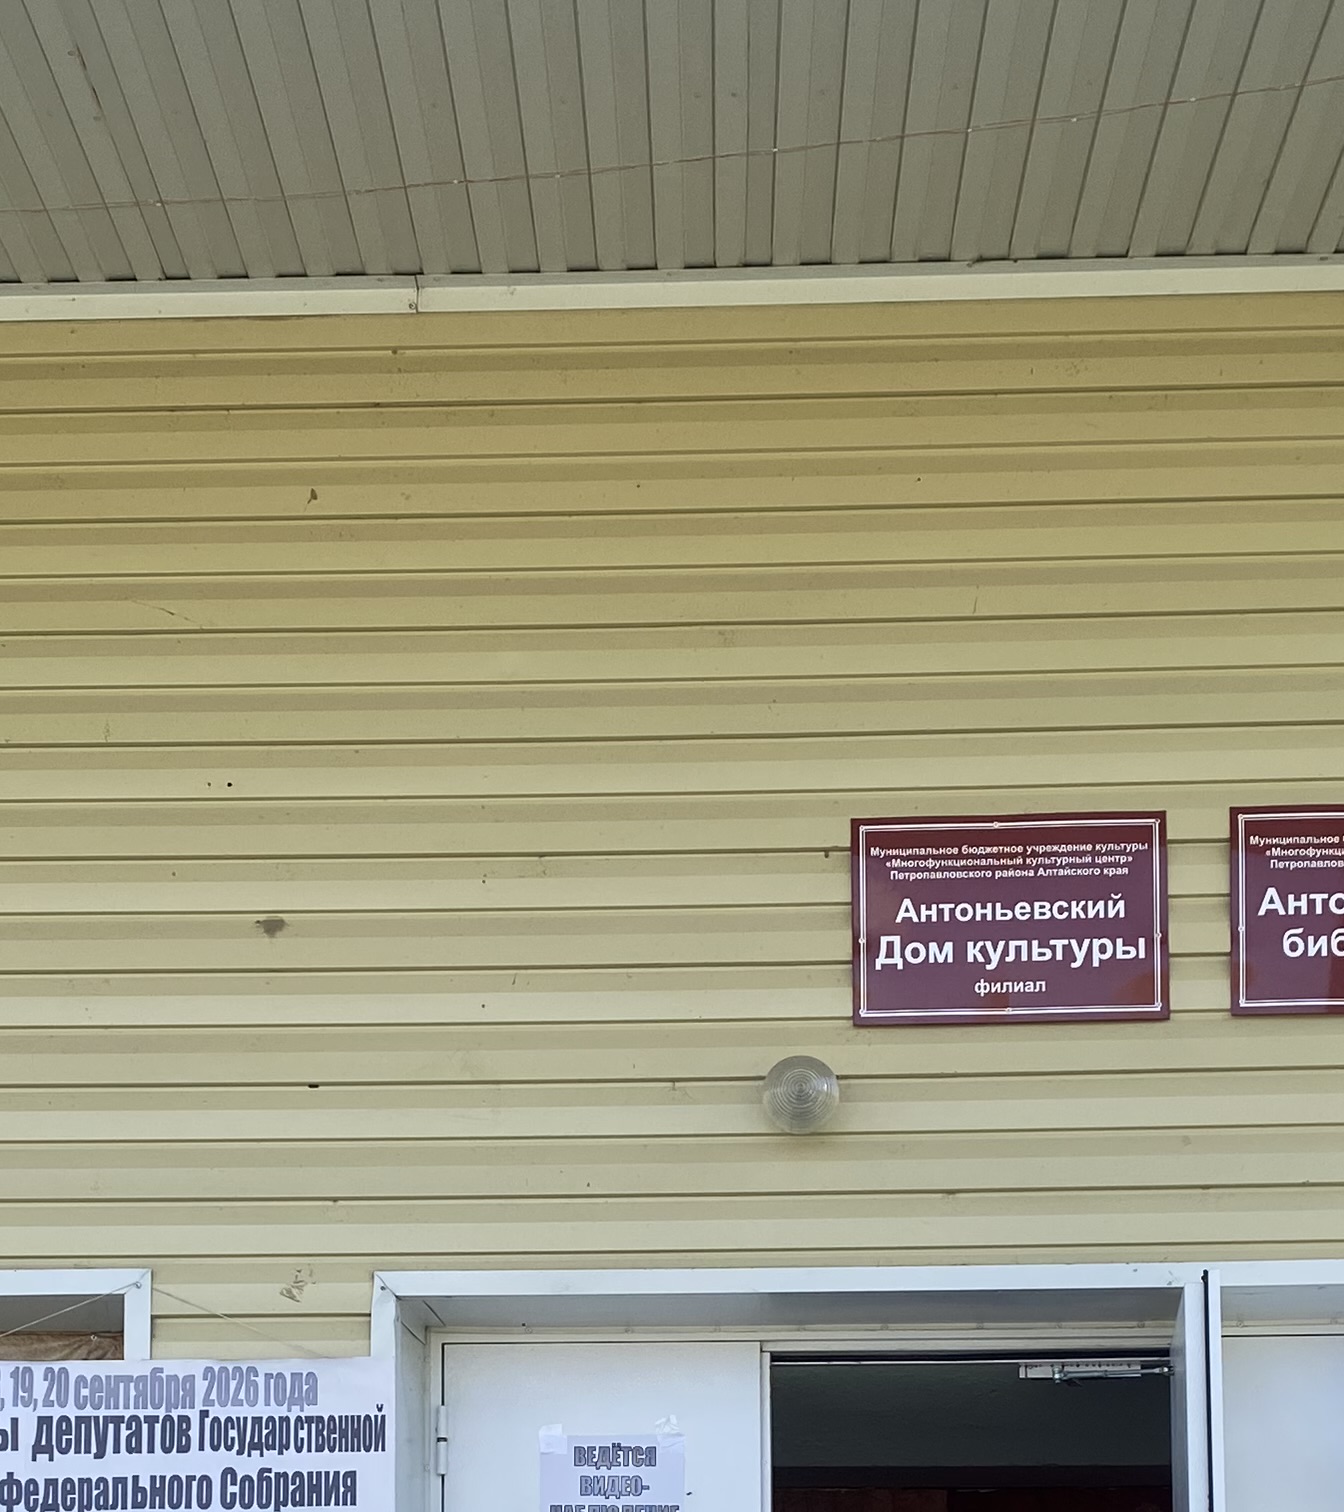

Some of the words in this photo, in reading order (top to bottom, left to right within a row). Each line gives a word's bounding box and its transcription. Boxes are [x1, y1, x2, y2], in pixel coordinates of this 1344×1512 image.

[870, 846, 958, 857] Муниципальное
[962, 844, 1023, 856] бюджетное
[1026, 843, 1093, 854] учреждение
[1095, 841, 1148, 852] культуры
[1249, 835, 1340, 846] Муниципальное
[886, 856, 1023, 868] «Многофункциональный
[1026, 855, 1092, 865] культурный
[1094, 854, 1133, 864] центр»
[890, 868, 992, 880] Петропавловского
[995, 868, 1034, 879] района
[1037, 866, 1101, 876] Алтайского
[1103, 866, 1129, 877] края
[895, 893, 1125, 923] Антоньевский
[875, 936, 953, 970] Дом
[967, 936, 1146, 970] культуры
[974, 979, 1046, 996] филиал
[10, 1366, 38, 1411] 19,
[43, 1366, 69, 1408] 20
[74, 1368, 196, 1413] сентября
[202, 1366, 258, 1408] 2026
[265, 1369, 318, 1411] года
[31, 1413, 191, 1461] депутатов
[198, 1404, 386, 1458] Государственной
[574, 1443, 657, 1470] ВЕДЁТСЯ
[220, 1467, 357, 1512] Собрания
[580, 1475, 650, 1499] ВИДЕО-
